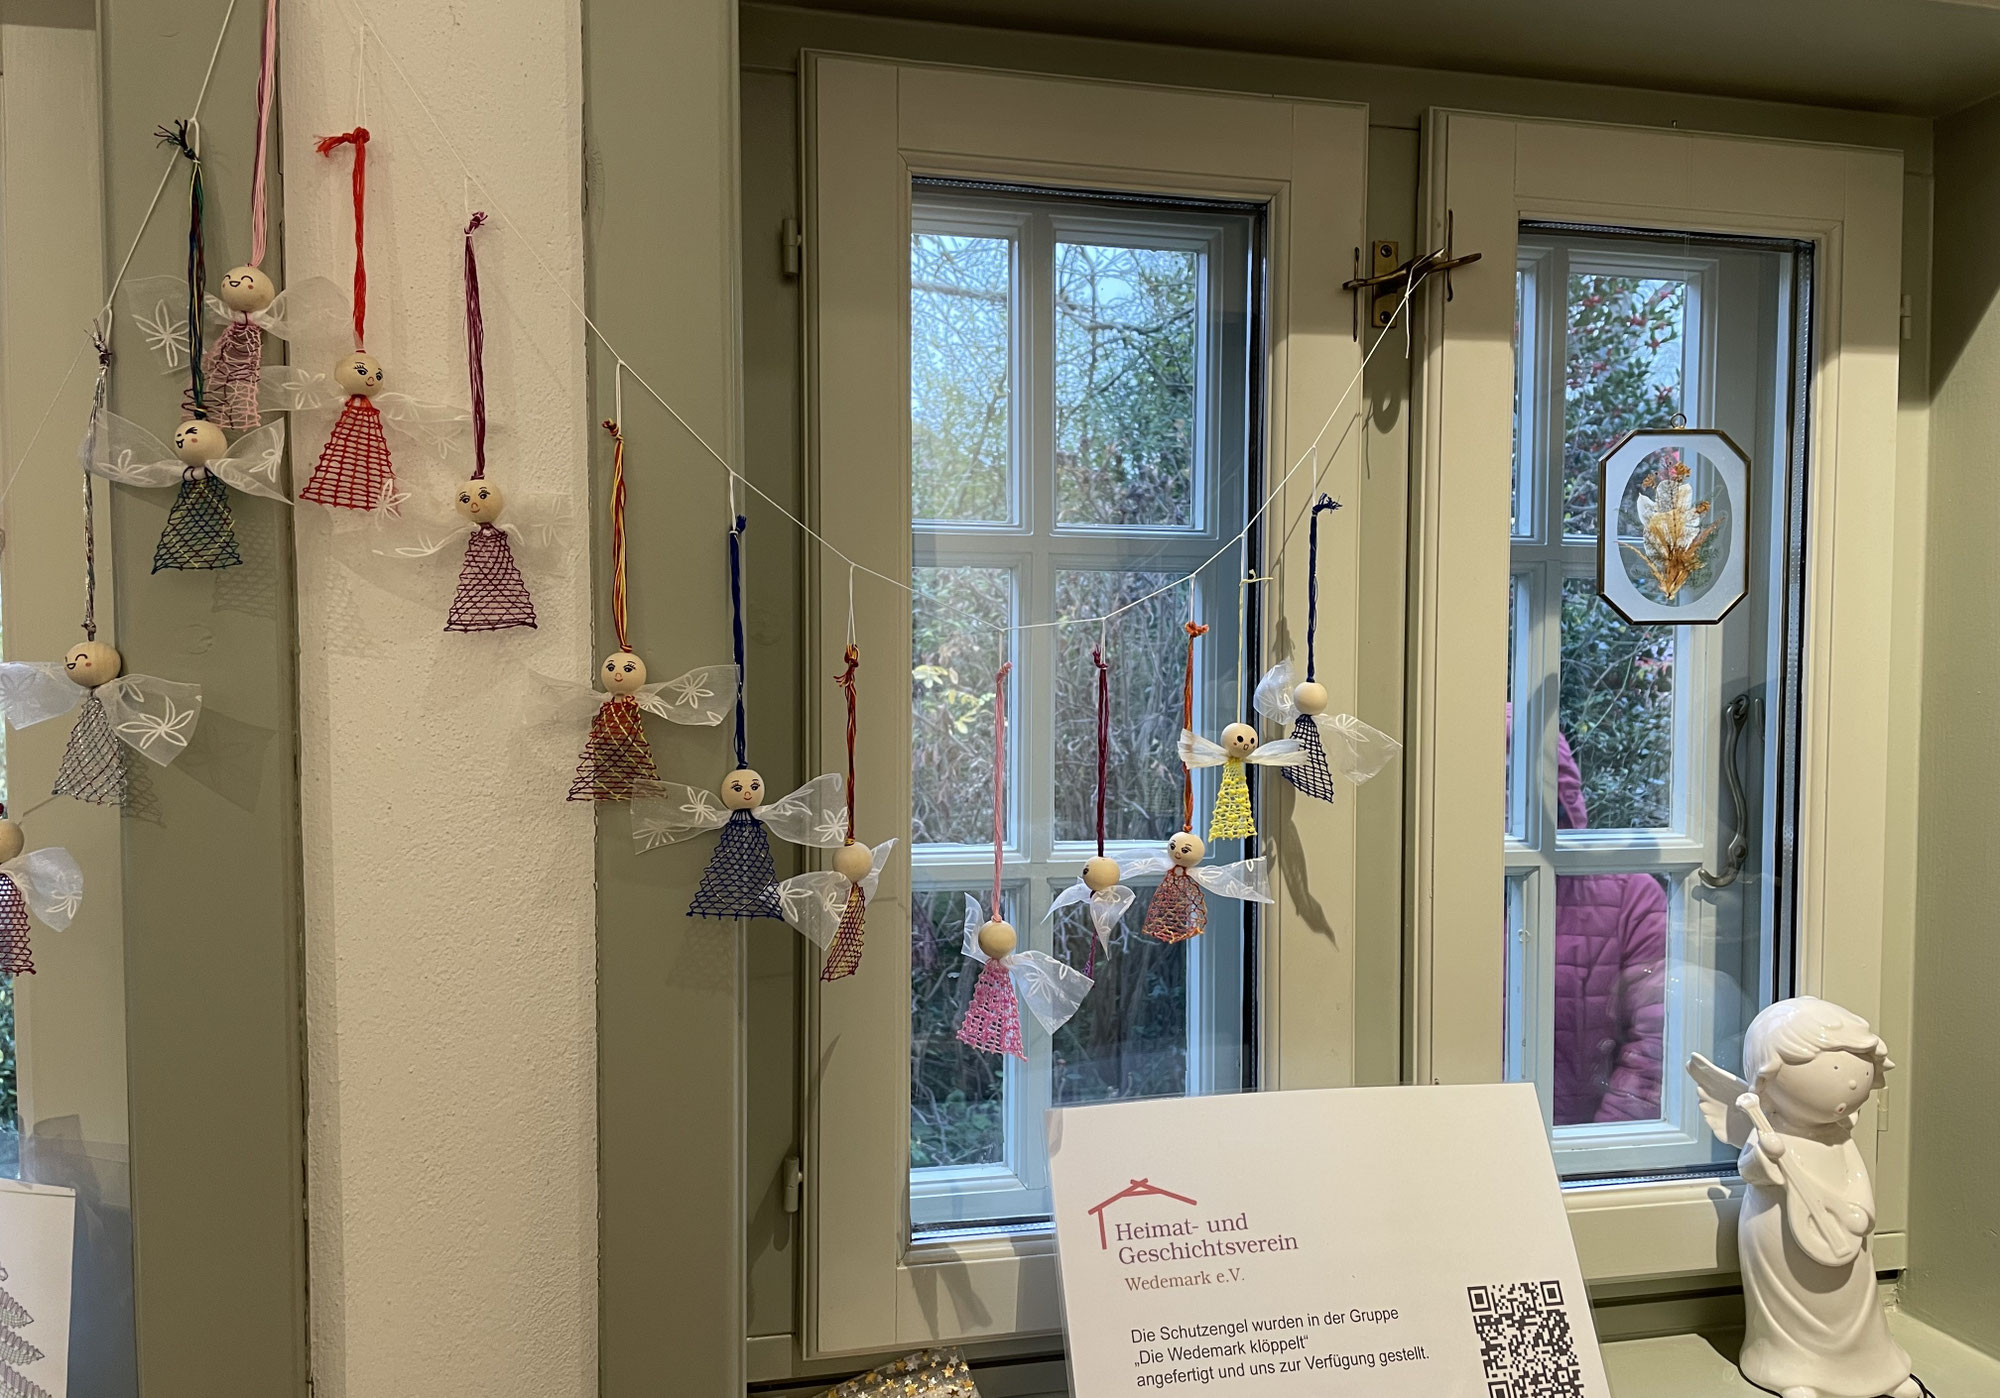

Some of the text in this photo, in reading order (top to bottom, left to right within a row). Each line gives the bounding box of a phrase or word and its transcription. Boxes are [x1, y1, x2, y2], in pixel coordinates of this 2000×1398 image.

[1114, 1212, 1249, 1241] Heimat- und
[1118, 1234, 1299, 1265] Geschichtsverein
[1124, 1268, 1245, 1291] Wedemark e.V.
[1131, 1308, 1399, 1344] Die Schutzengel wurden in der Gruppe
[1167, 1341, 1247, 1362] Wedemark
[1137, 1346, 1430, 1389] angefertigt und uns zur Verfügung gestellt.
